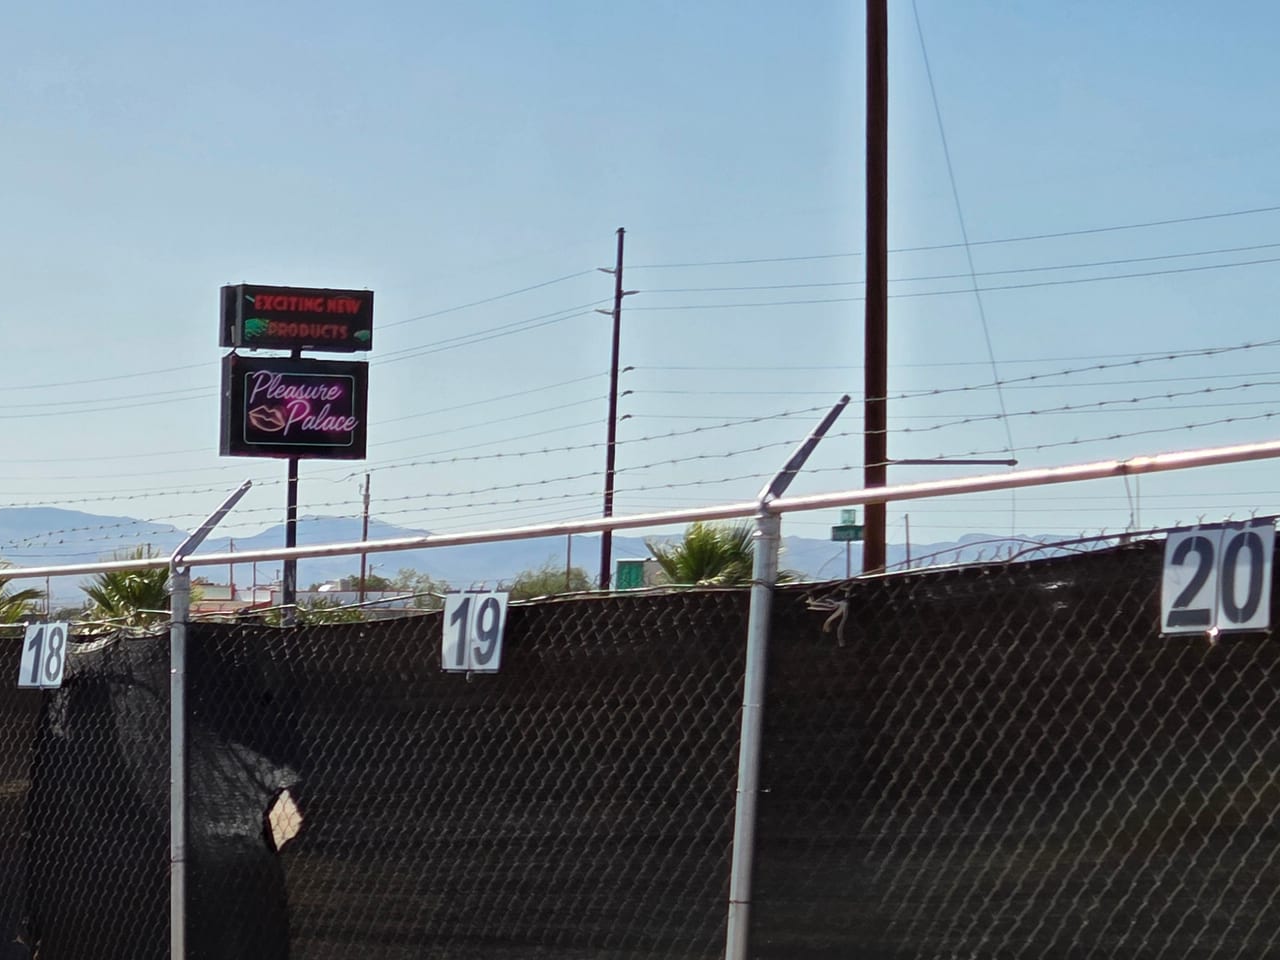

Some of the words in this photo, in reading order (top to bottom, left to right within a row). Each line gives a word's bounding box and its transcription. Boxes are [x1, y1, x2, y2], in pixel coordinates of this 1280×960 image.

[254, 295, 323, 313] EXCITING
[326, 296, 362, 314] NEW
[268, 321, 349, 339] PRODUCTS
[249, 369, 343, 405] Pleasure
[283, 399, 359, 437] Palace
[1166, 533, 1266, 630] 20
[449, 595, 500, 667] 19
[28, 627, 64, 684] 18
